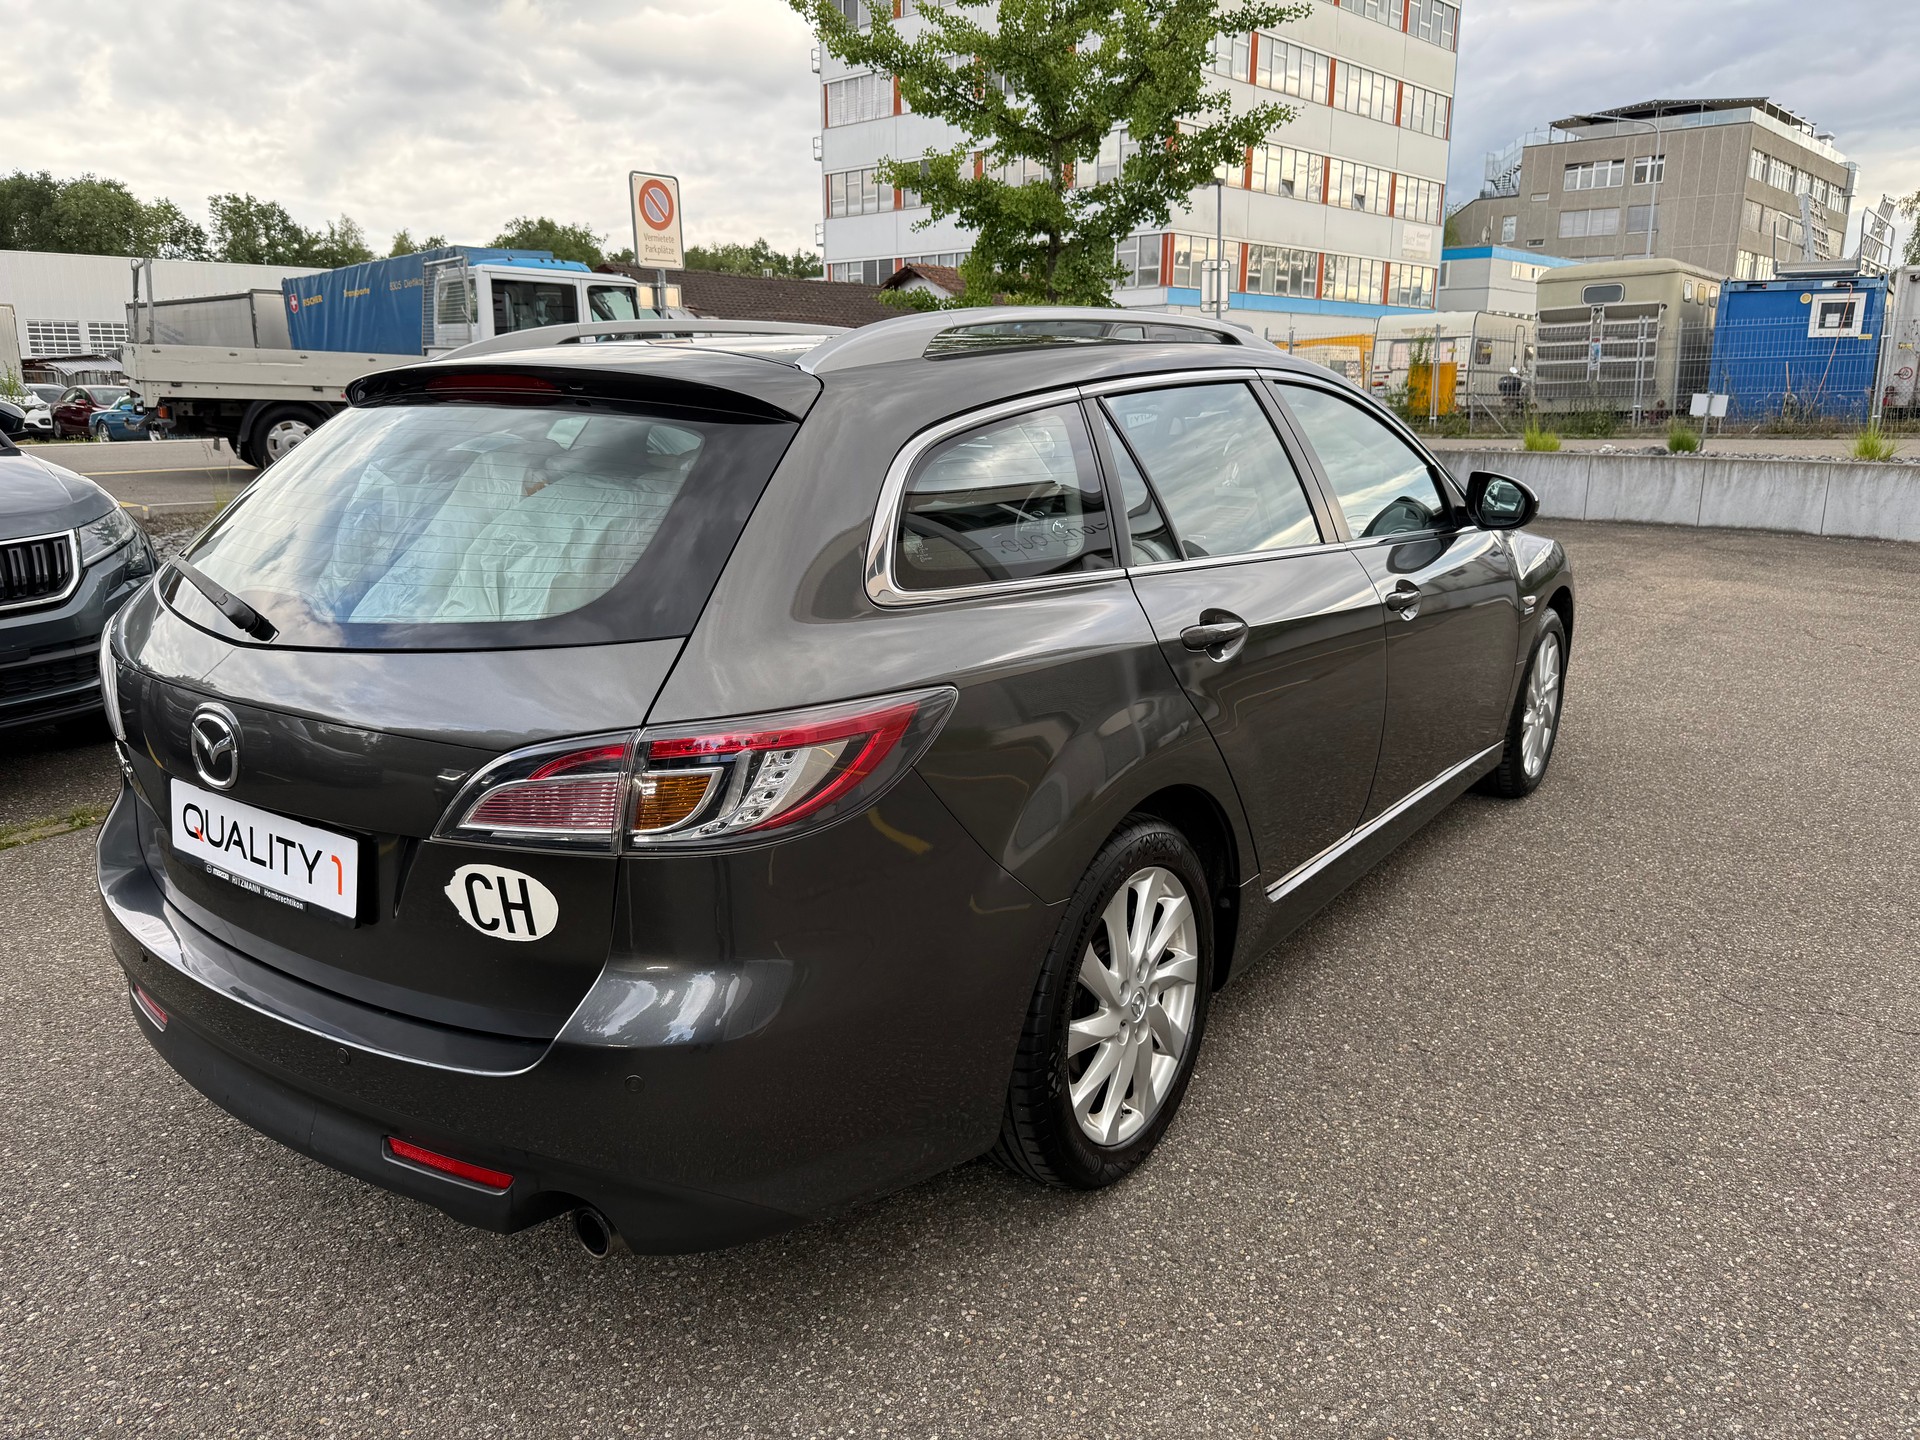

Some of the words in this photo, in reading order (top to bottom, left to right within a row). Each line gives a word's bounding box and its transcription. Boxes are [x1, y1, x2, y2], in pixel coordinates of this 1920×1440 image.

[643, 233, 675, 243] Vermietete
[645, 244, 675, 255] Parkplätze
[183, 802, 323, 885] QUALITY
[231, 875, 261, 894] RITZMANN
[264, 889, 304, 910] Hombrechtikon
[465, 872, 537, 936] CH
